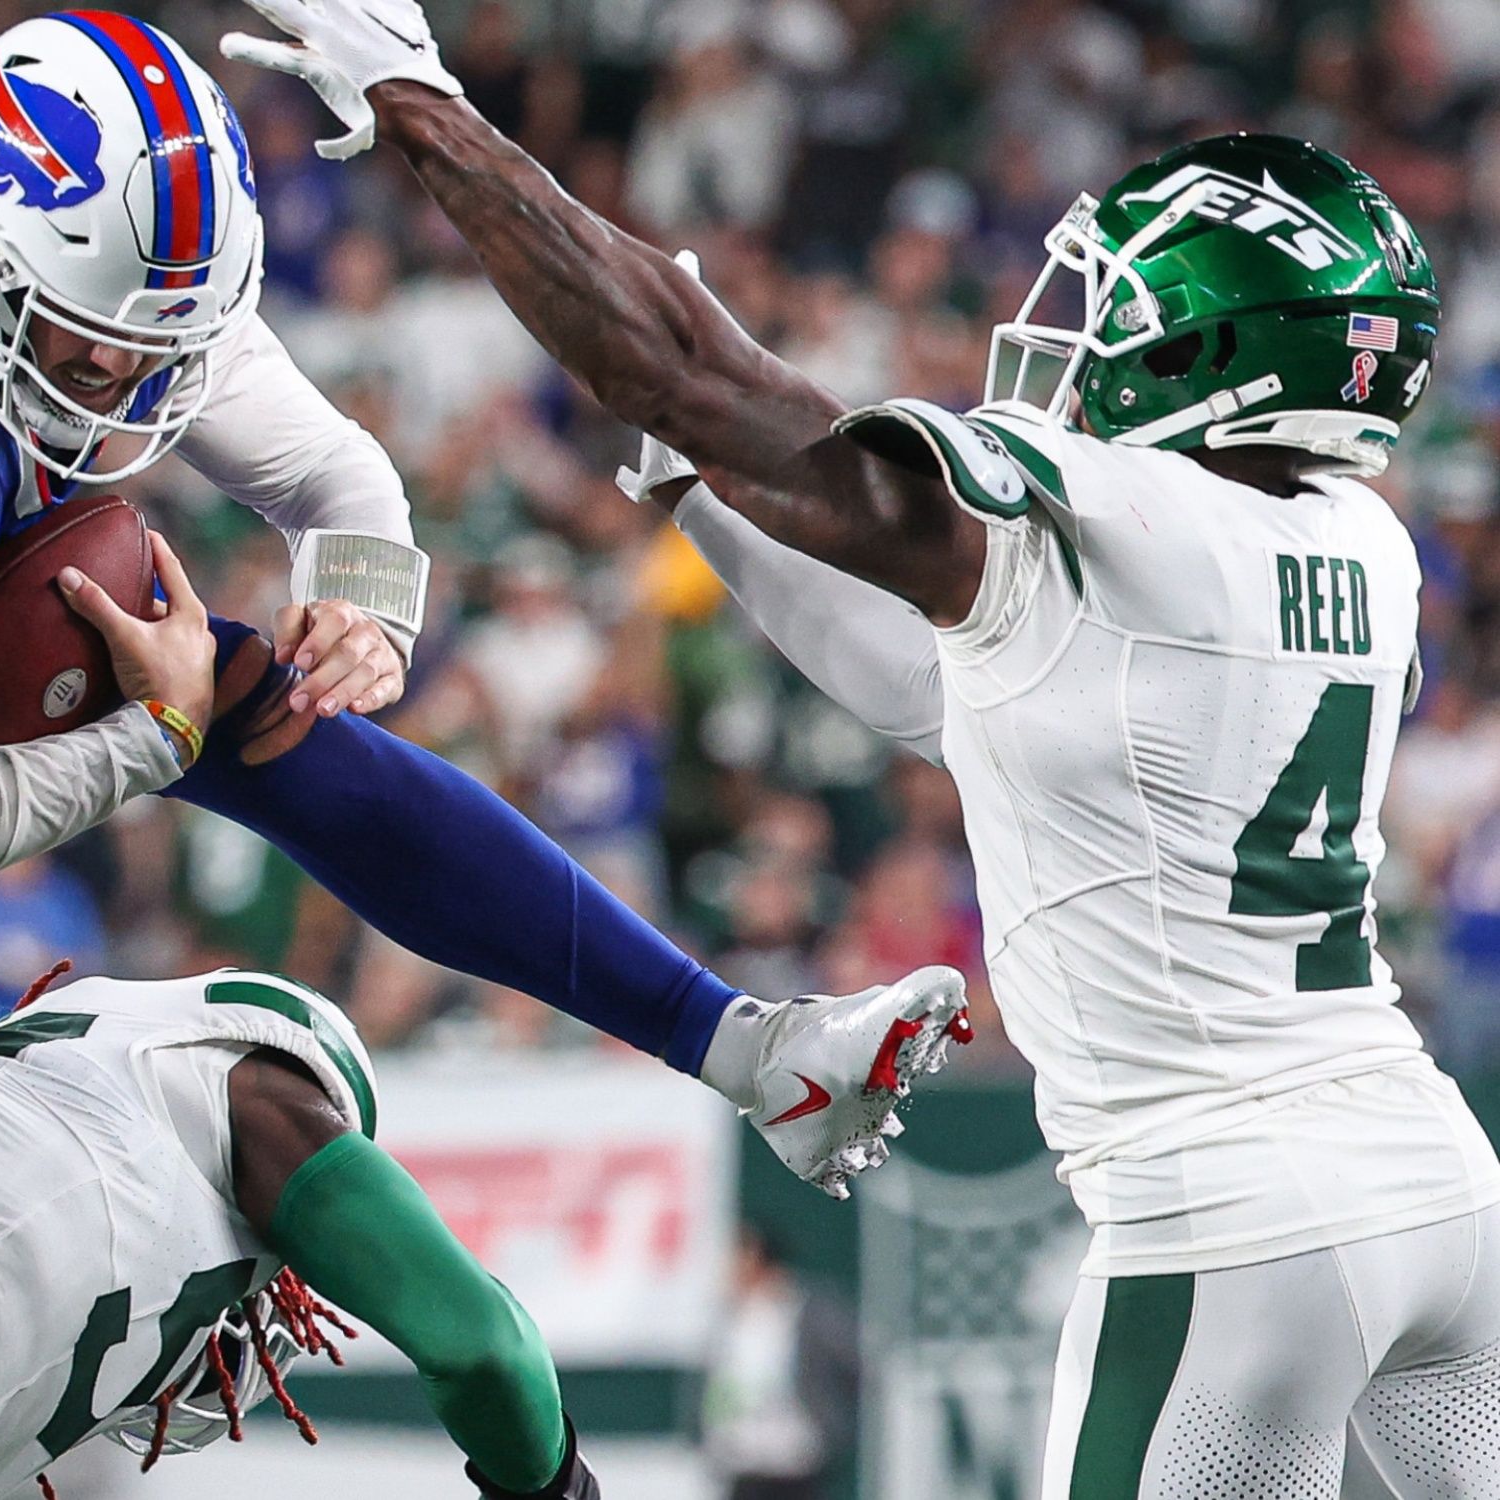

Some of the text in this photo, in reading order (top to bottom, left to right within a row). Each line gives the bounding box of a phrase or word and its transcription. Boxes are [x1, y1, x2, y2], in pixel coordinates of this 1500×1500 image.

[1117, 164, 1367, 271] JETS
[1402, 358, 1429, 408] 4
[1276, 553, 1372, 656] REED
[1228, 682, 1375, 993] 4
